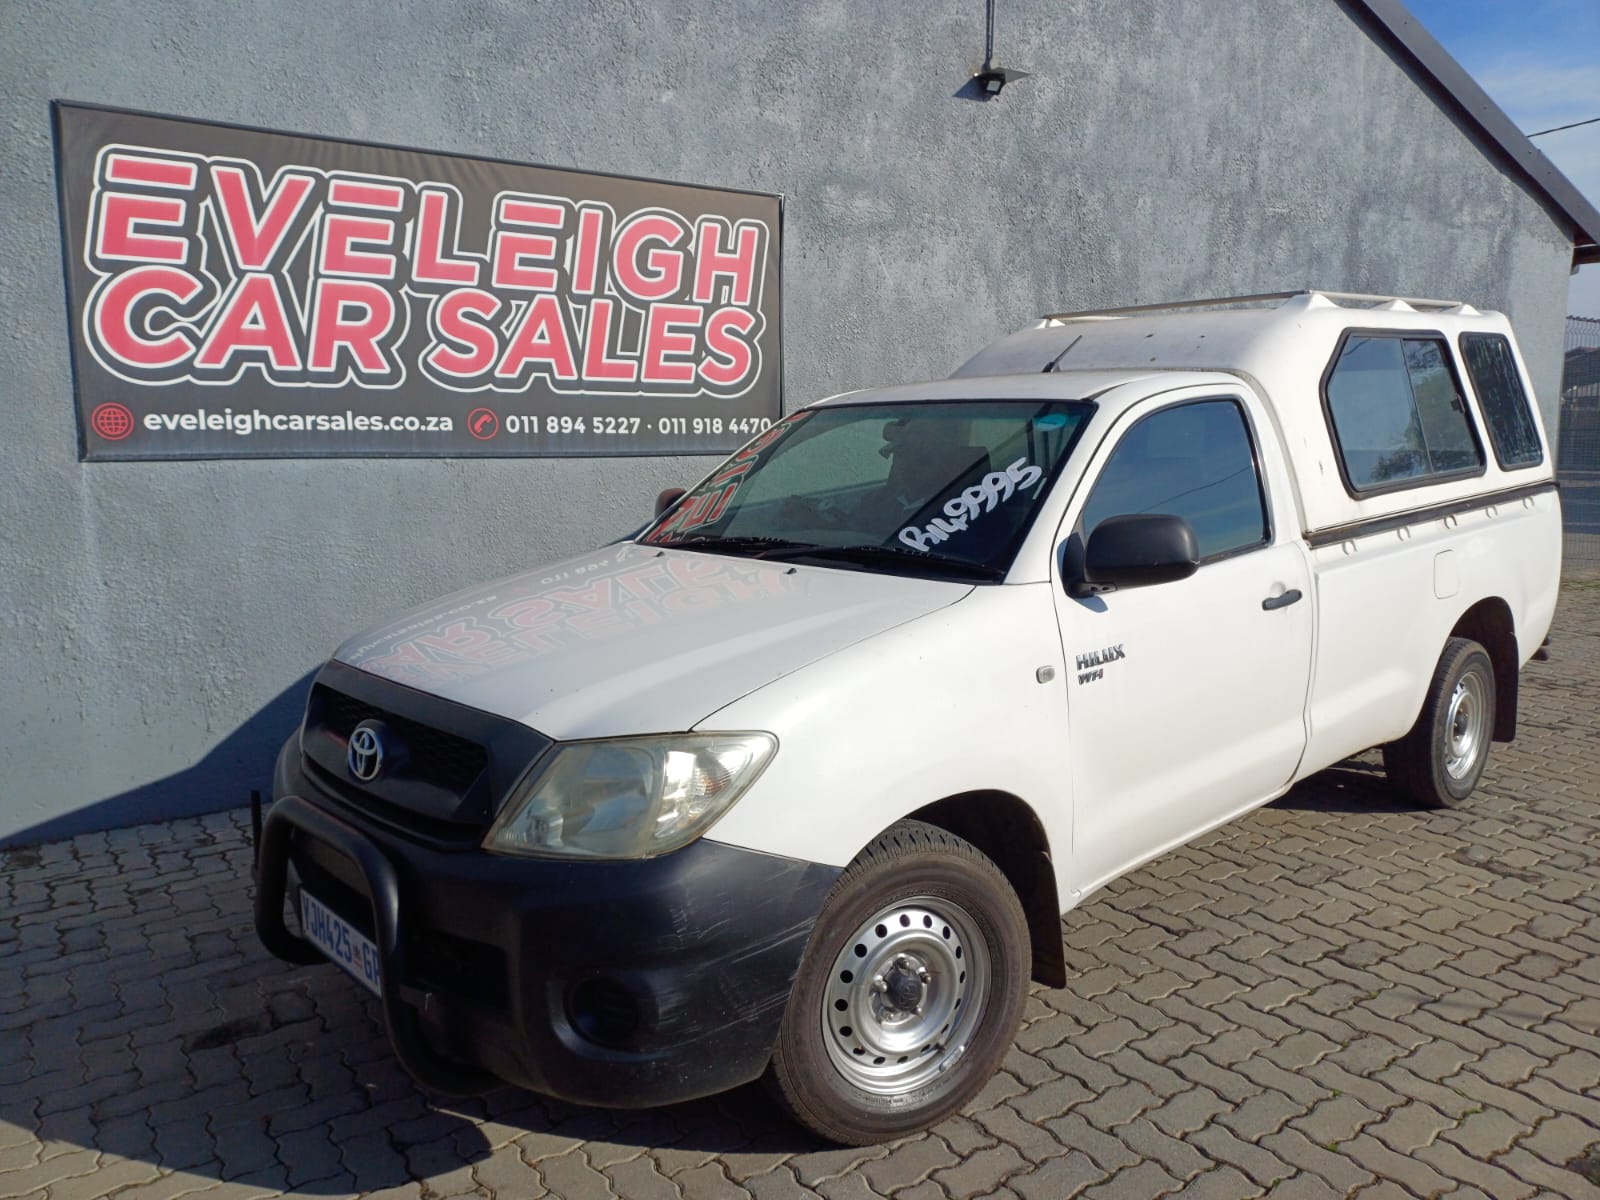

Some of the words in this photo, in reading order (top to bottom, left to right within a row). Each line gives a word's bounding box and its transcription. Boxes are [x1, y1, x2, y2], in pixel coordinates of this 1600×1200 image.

[98, 156, 758, 305] EVELEIGH
[97, 267, 393, 371] CAR
[430, 289, 755, 385] SALES
[143, 408, 453, 435] eveleighcarsales.co.za
[505, 415, 539, 434] 011
[546, 416, 586, 434] 894
[592, 417, 641, 435] 5227
[658, 417, 687, 434] 011
[692, 417, 723, 435] 918
[728, 417, 771, 434] 4470
[1075, 643, 1126, 671] HILUX
